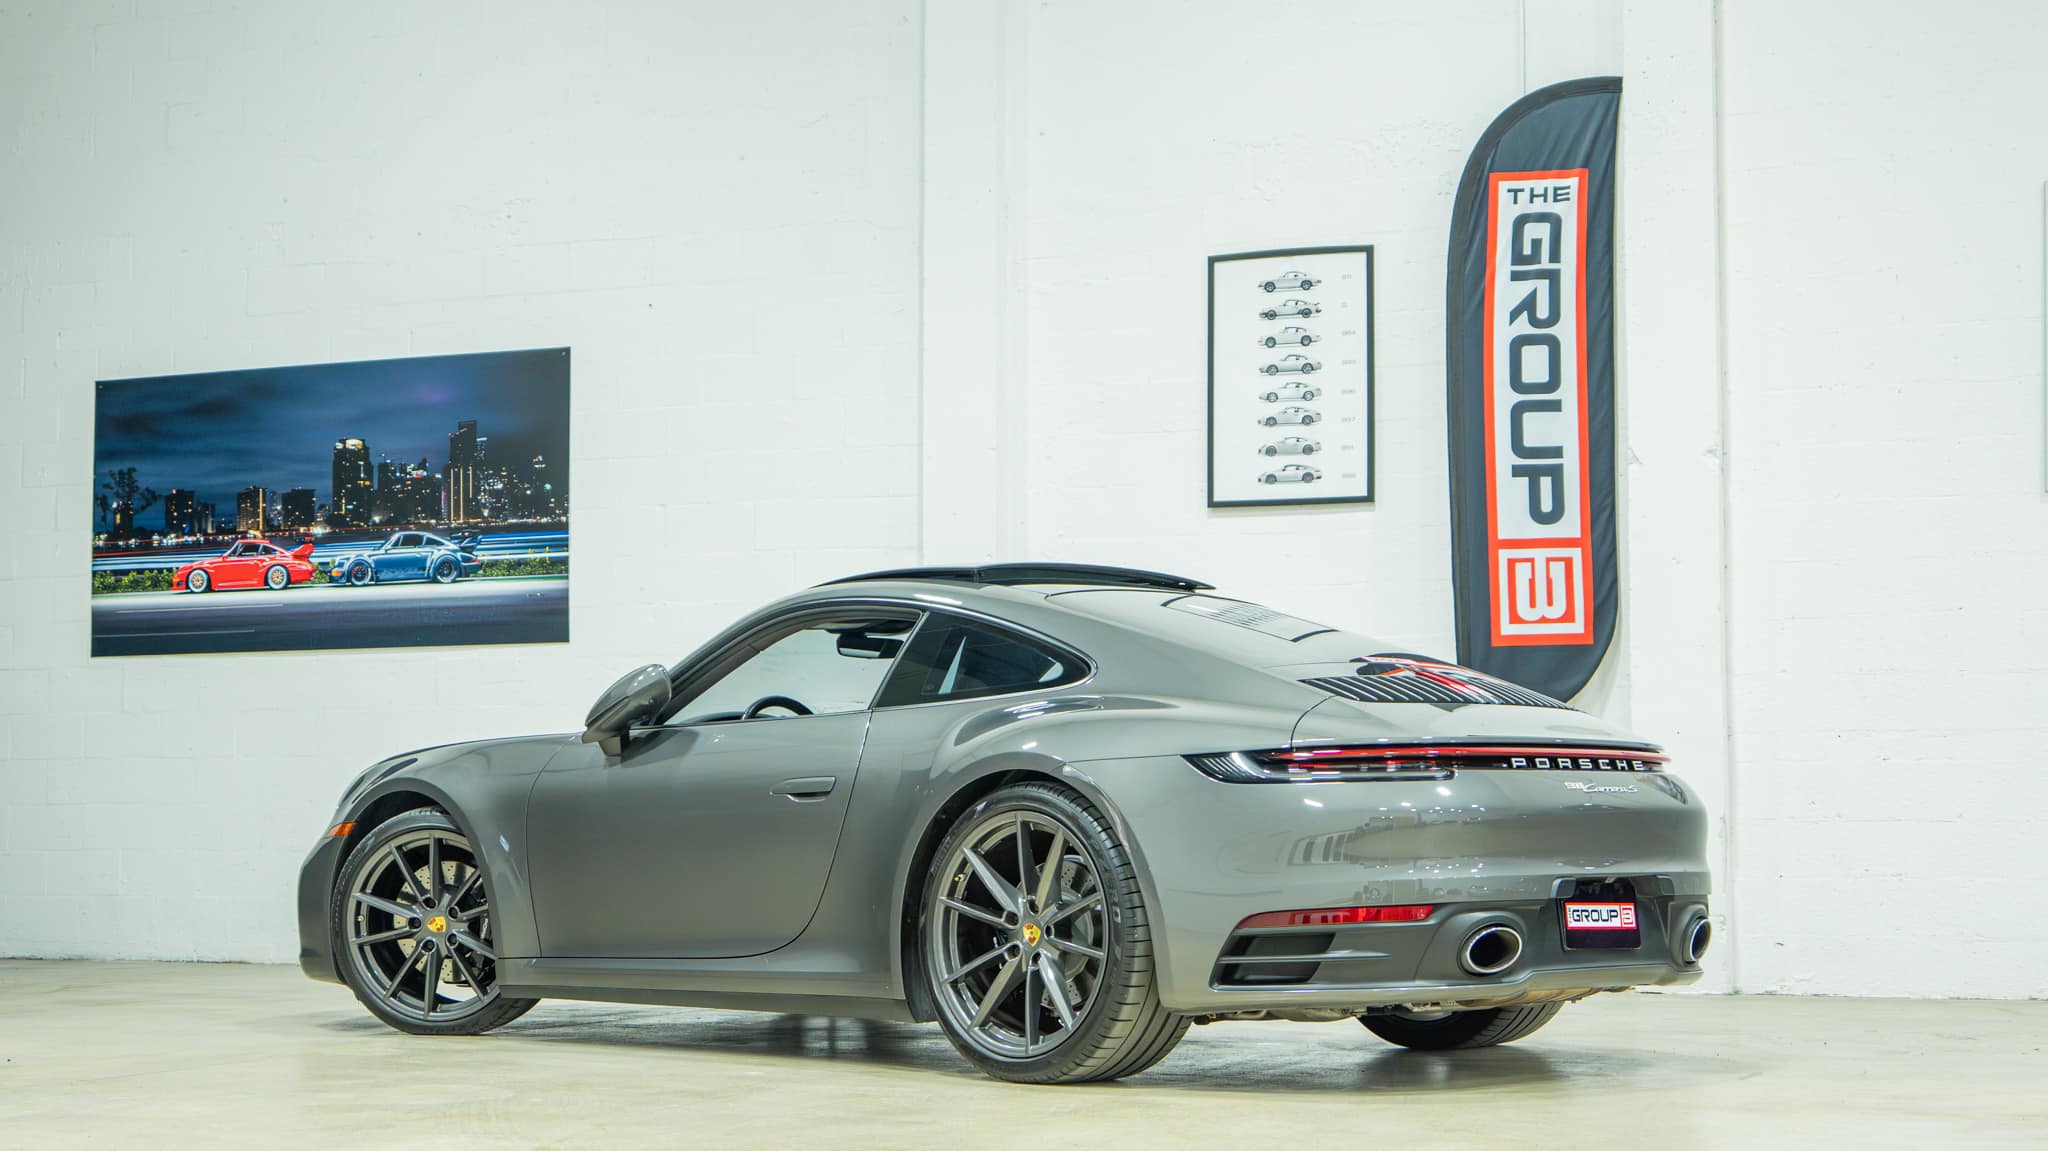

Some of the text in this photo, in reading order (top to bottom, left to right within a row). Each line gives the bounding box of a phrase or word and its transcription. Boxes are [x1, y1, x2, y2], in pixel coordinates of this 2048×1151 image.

[1507, 185, 1571, 204] THE
[1509, 211, 1566, 525] GROUP
[1511, 757, 1645, 771] PORSCHE
[1572, 909, 1618, 922] GROUP
